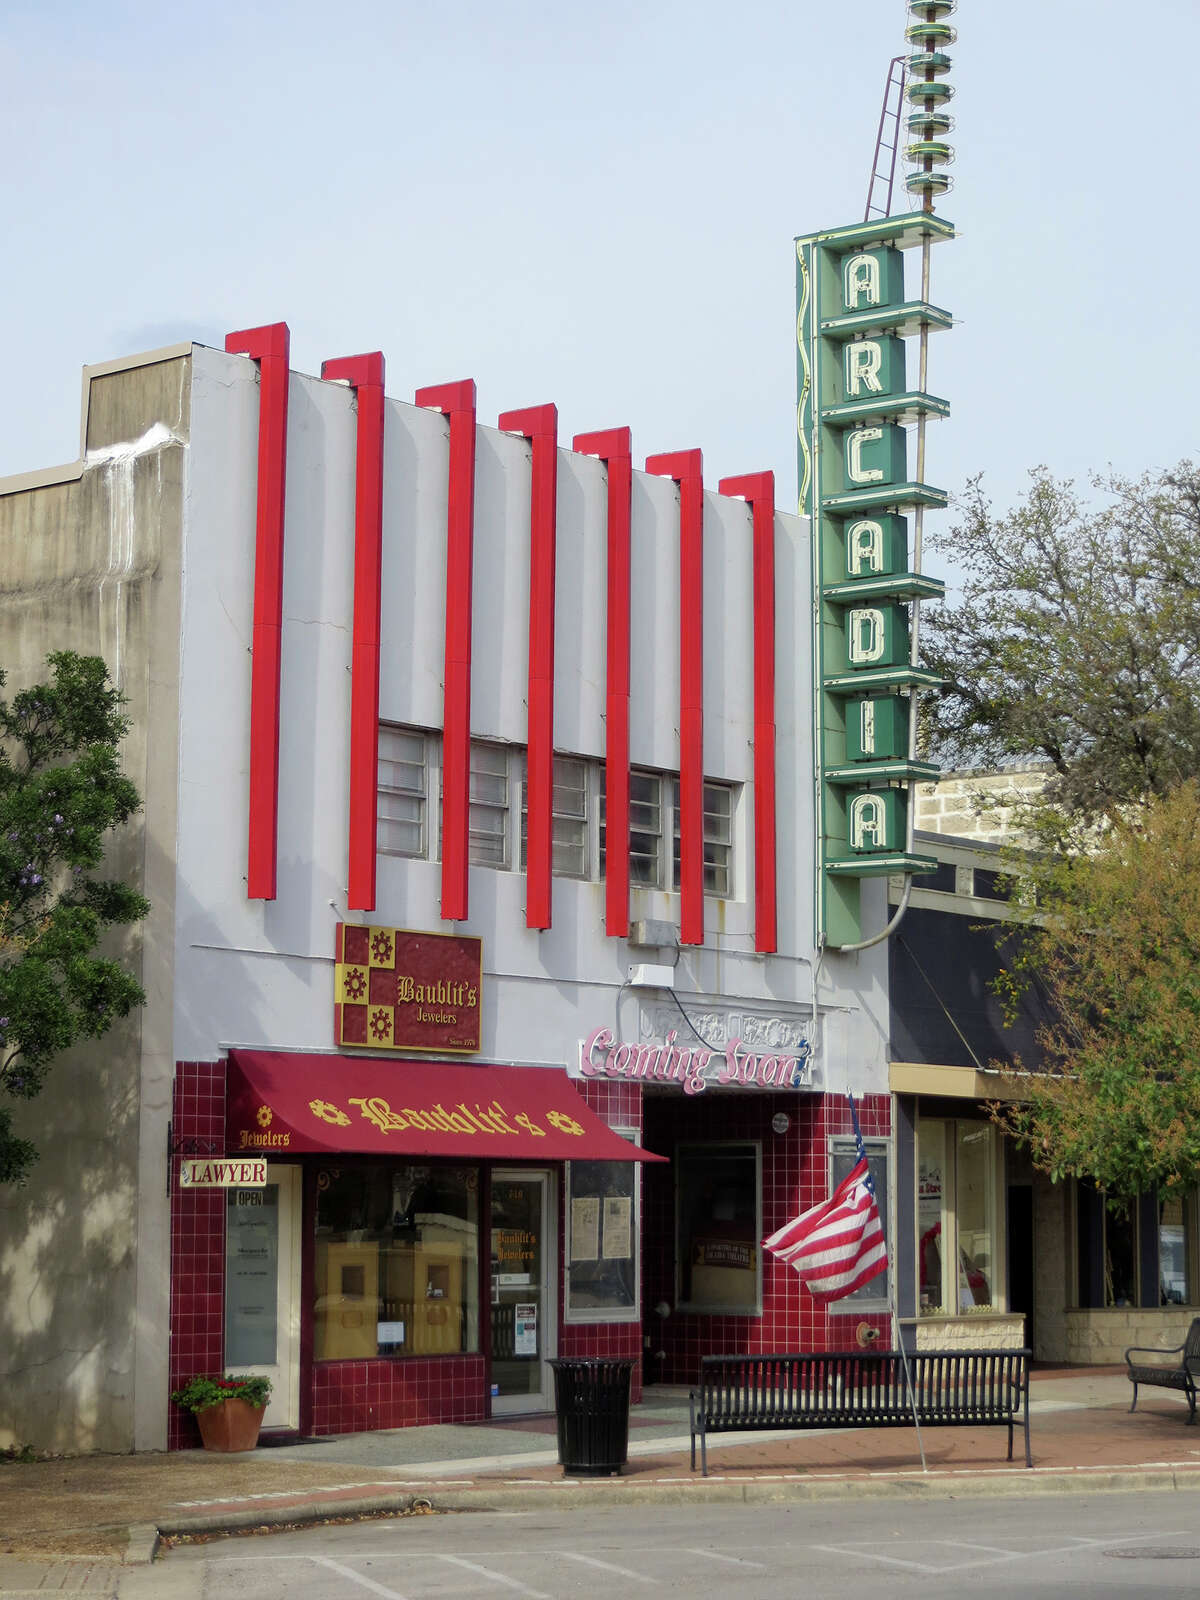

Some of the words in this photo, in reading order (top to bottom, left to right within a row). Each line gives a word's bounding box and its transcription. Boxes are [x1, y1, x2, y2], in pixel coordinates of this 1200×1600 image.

[844, 253, 887, 848] ARCADIA
[397, 975, 477, 1008] Baublit's
[416, 1007, 457, 1024] Jewelers
[580, 1025, 712, 1095] Coming
[348, 1097, 546, 1137] Baublit's
[239, 1129, 291, 1149] Jewelers
[191, 1163, 265, 1183] LAWYER
[238, 1191, 263, 1206] OPEN
